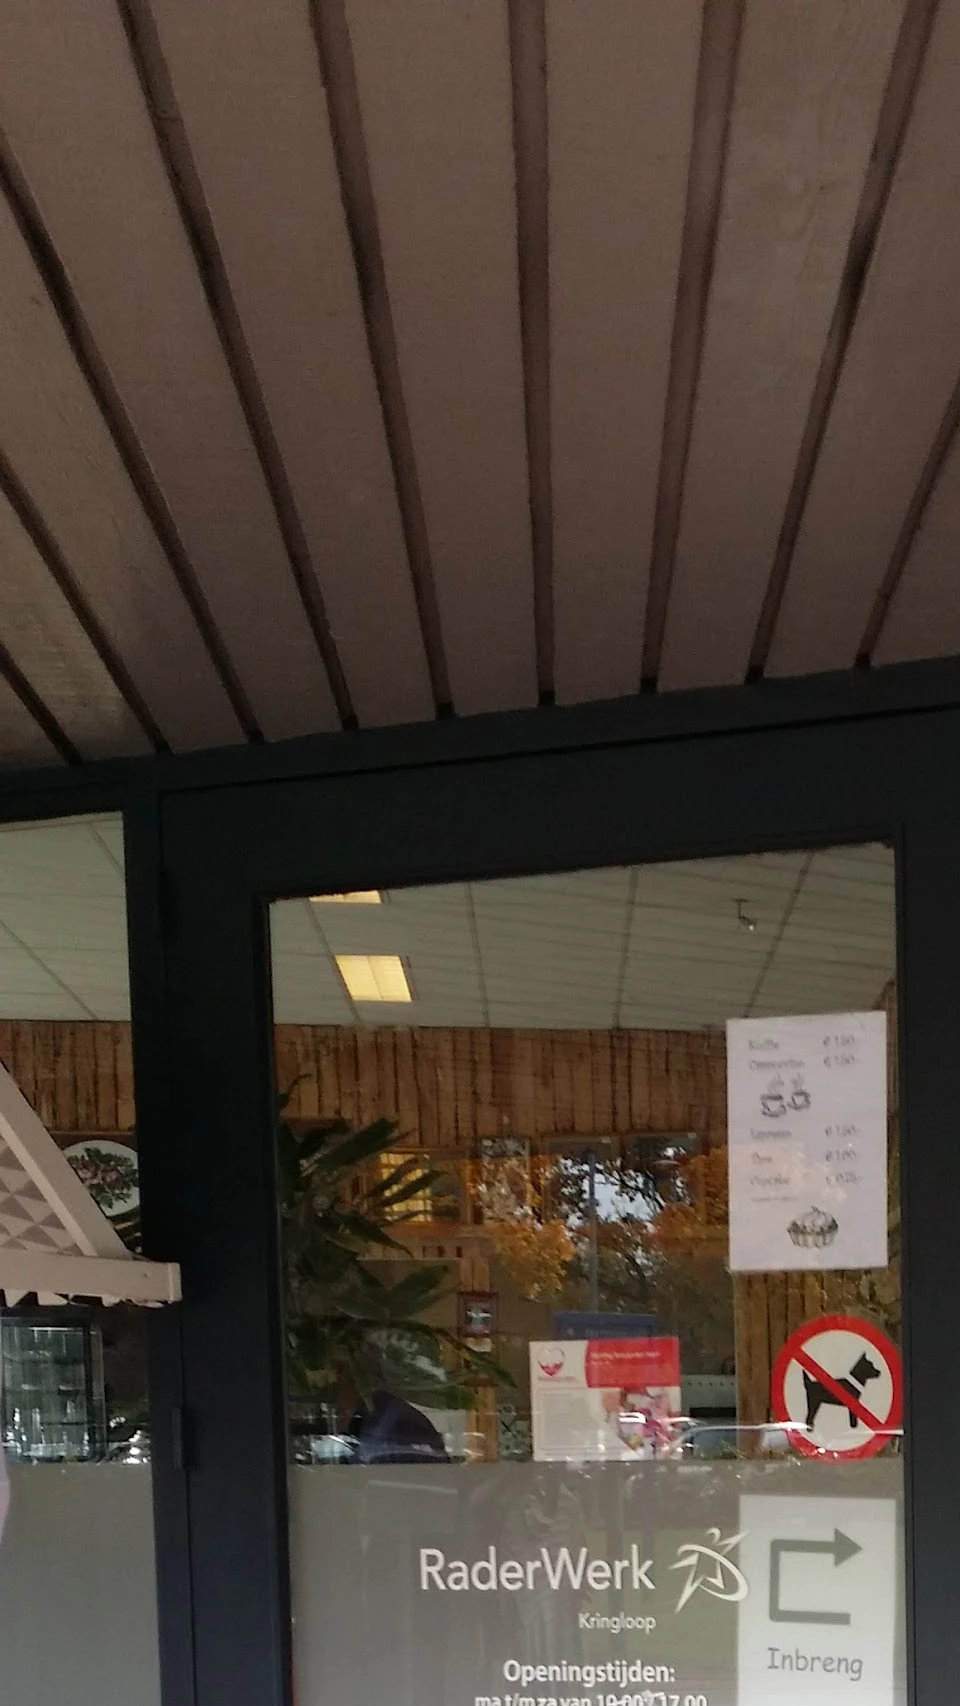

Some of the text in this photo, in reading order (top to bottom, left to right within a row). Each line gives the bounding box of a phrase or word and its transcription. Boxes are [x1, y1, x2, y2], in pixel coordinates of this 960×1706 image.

[419, 1544, 656, 1591] RaderWerk
[578, 1612, 657, 1634] Kringloop
[502, 1659, 676, 1688] Openingstijden:
[767, 1647, 863, 1681] Inbreng
